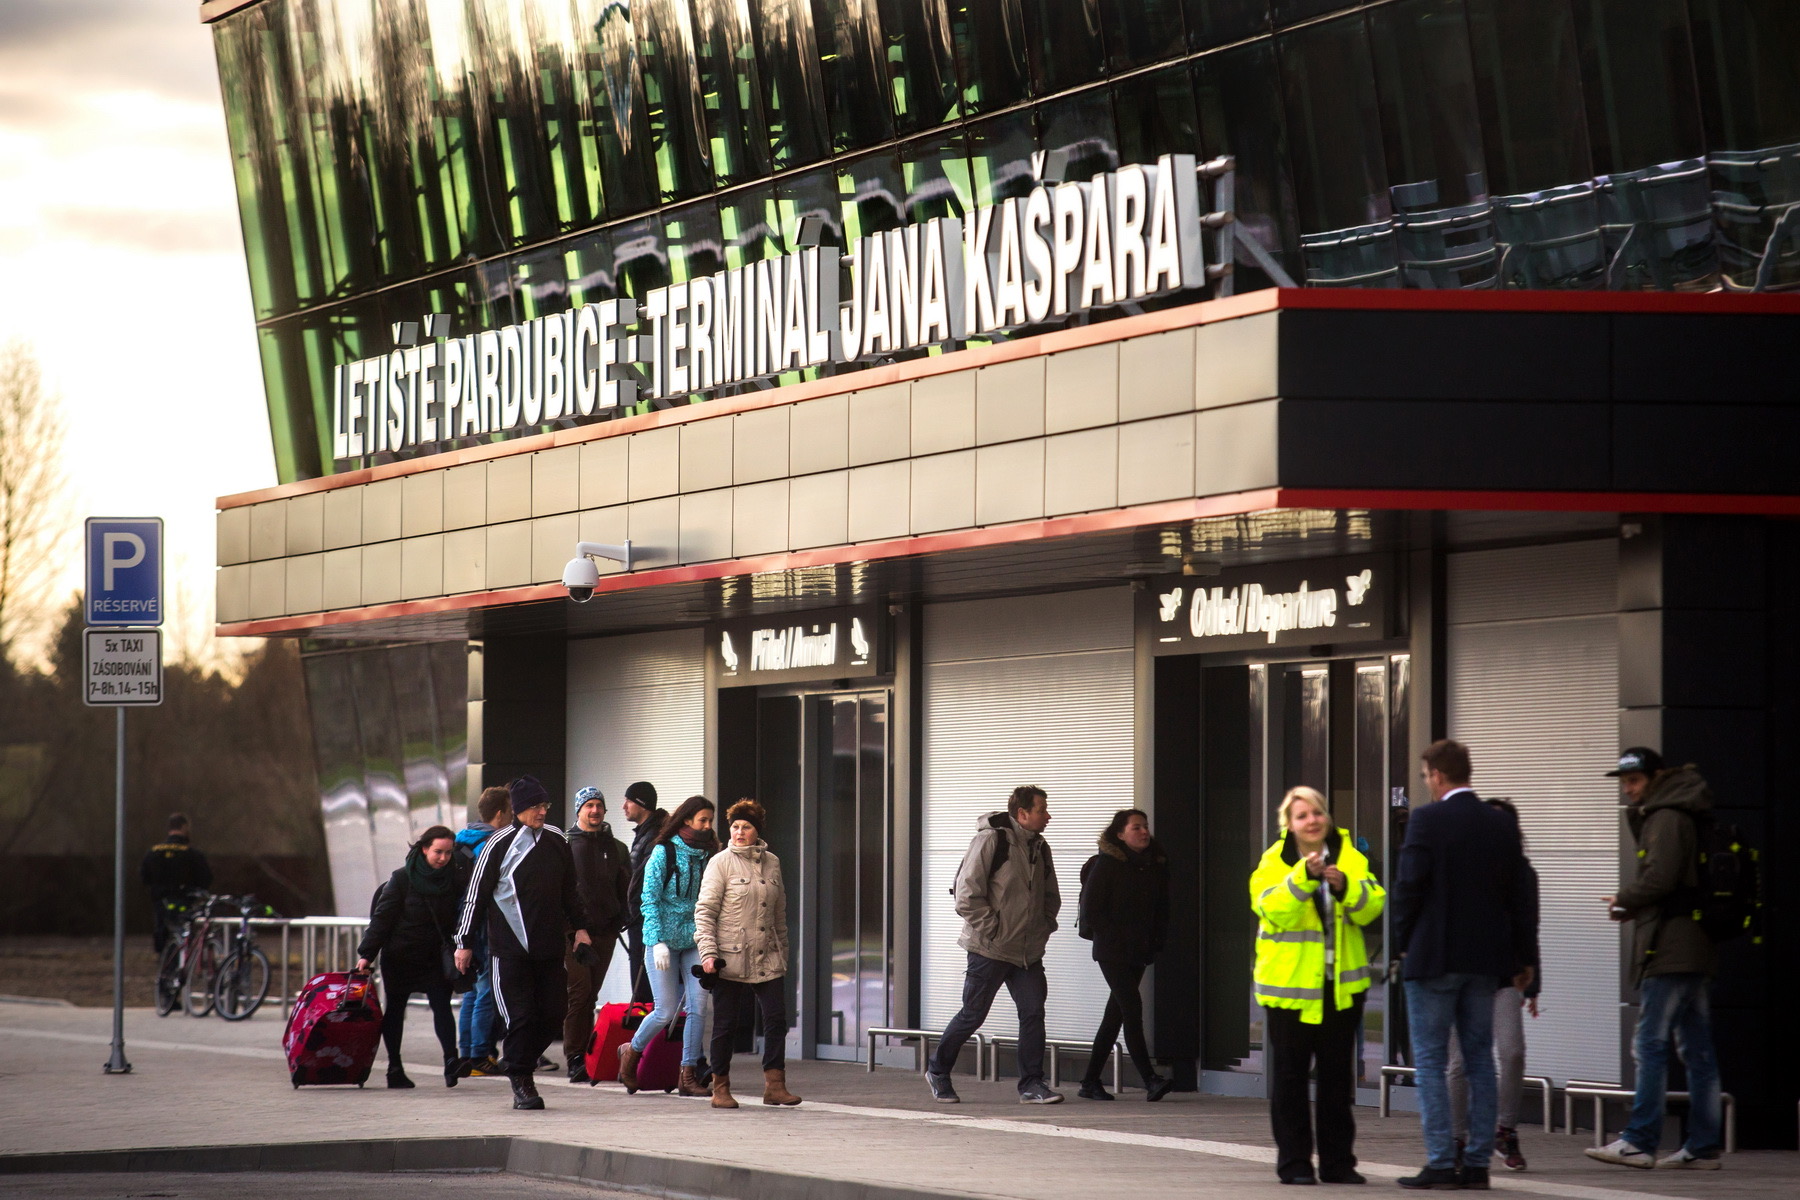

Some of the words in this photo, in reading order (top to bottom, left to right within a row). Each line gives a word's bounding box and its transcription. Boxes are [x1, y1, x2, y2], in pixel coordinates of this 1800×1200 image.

[334, 314, 437, 459] LETIŠTĚ
[444, 298, 618, 440] PARDUBICE
[646, 217, 829, 399] TERMINÁL
[841, 217, 949, 362] JANA
[965, 150, 1182, 336] KAŠPARA
[103, 532, 146, 591] P
[93, 597, 158, 613] RÉSERVÉ
[105, 639, 118, 652] 5x
[120, 639, 143, 652] TAXI
[92, 659, 152, 676] ZÁSOBOVÁNÍ
